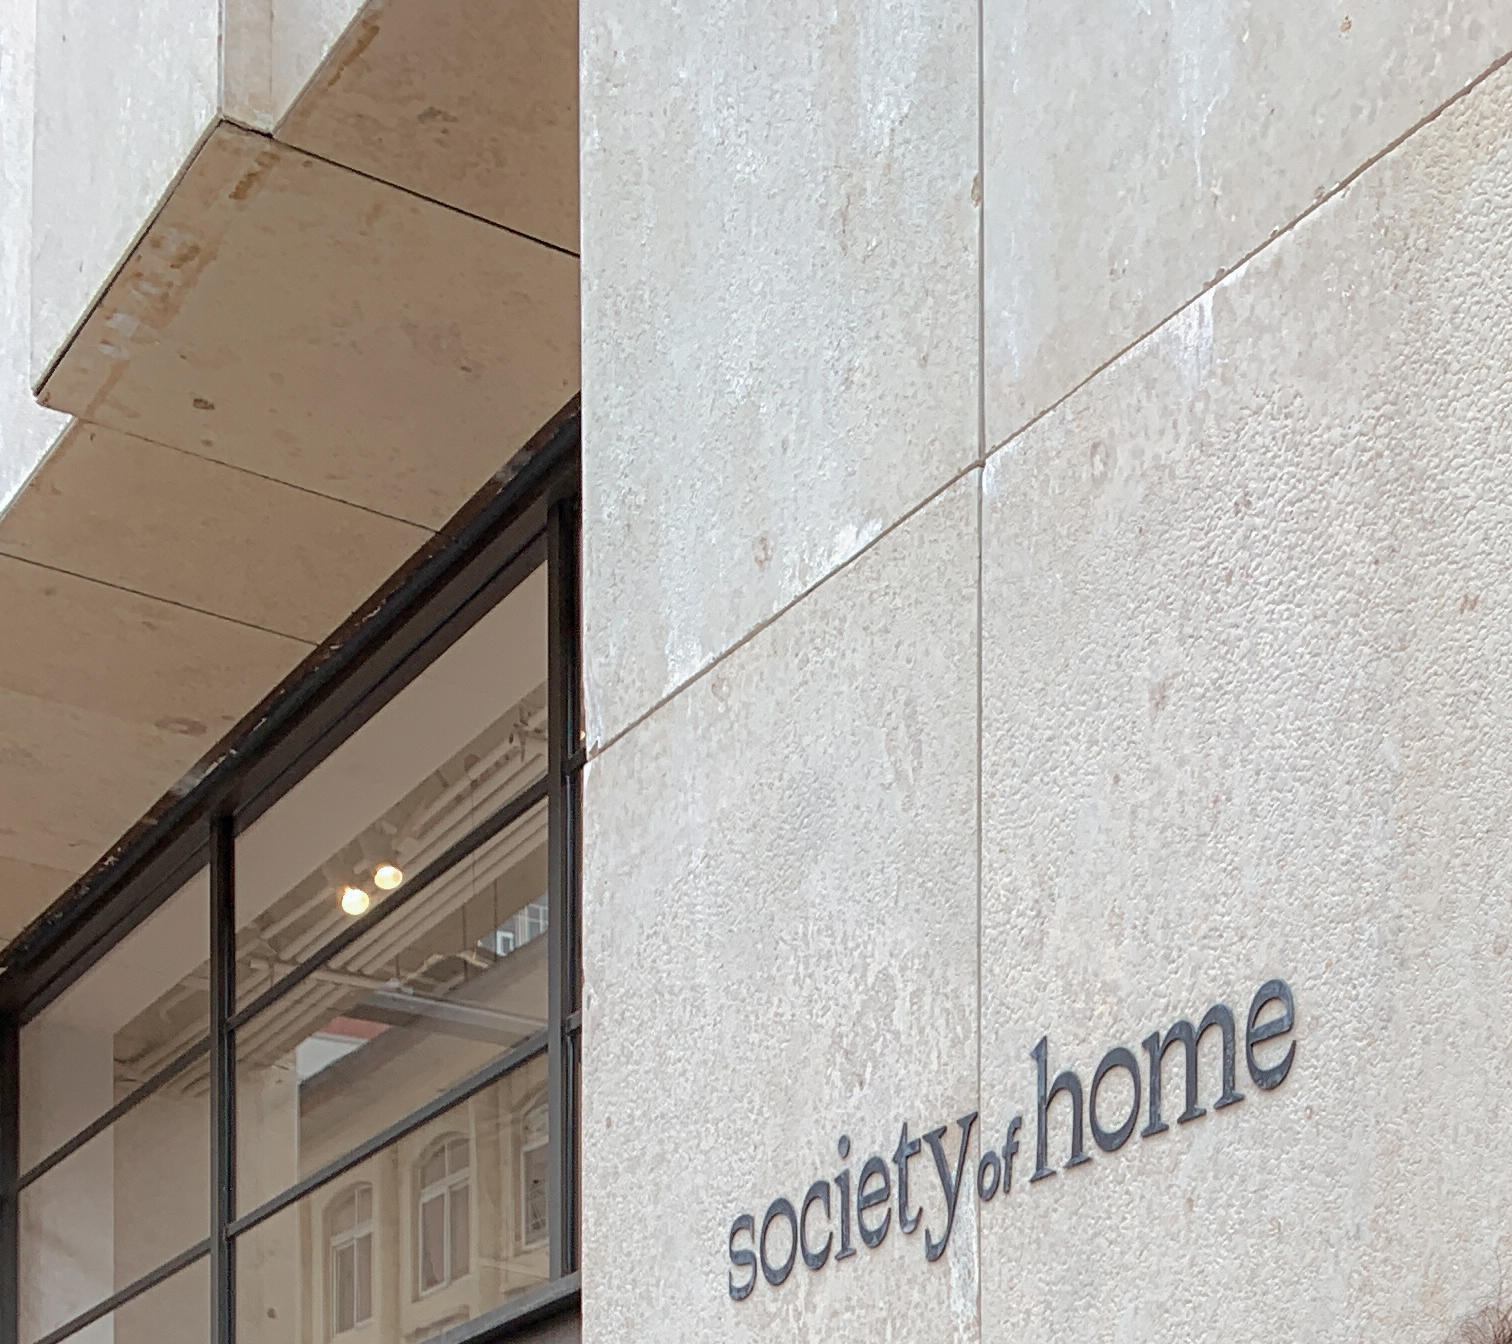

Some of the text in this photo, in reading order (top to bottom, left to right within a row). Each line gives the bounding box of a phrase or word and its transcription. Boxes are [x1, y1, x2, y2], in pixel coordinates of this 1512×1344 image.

[728, 978, 1297, 1301] society of home
